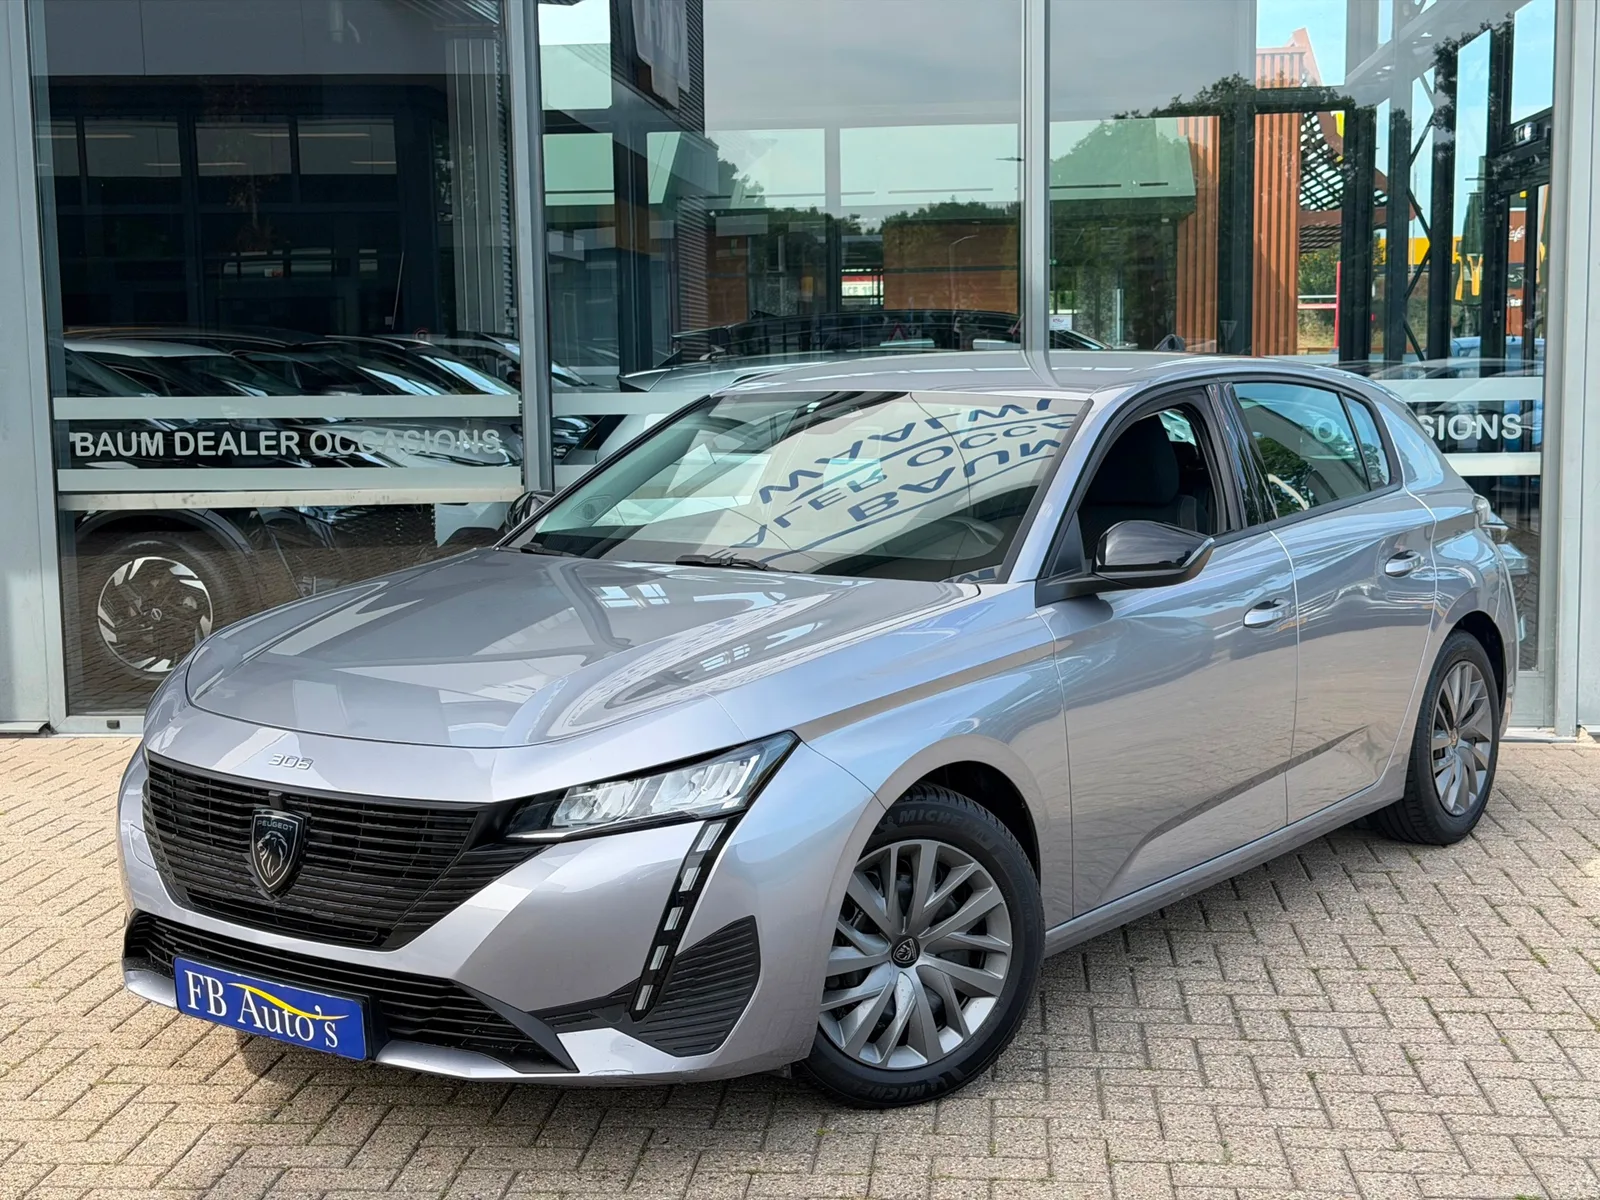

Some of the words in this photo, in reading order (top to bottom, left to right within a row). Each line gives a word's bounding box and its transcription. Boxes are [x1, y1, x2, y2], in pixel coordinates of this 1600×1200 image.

[74, 431, 165, 457] BAUM
[174, 430, 300, 457] DEALER
[309, 428, 501, 456] OCCASIONS
[268, 753, 314, 770] 308
[256, 819, 294, 832] PEUGEOT
[184, 970, 227, 1017] FB
[237, 988, 338, 1048] Auto's
